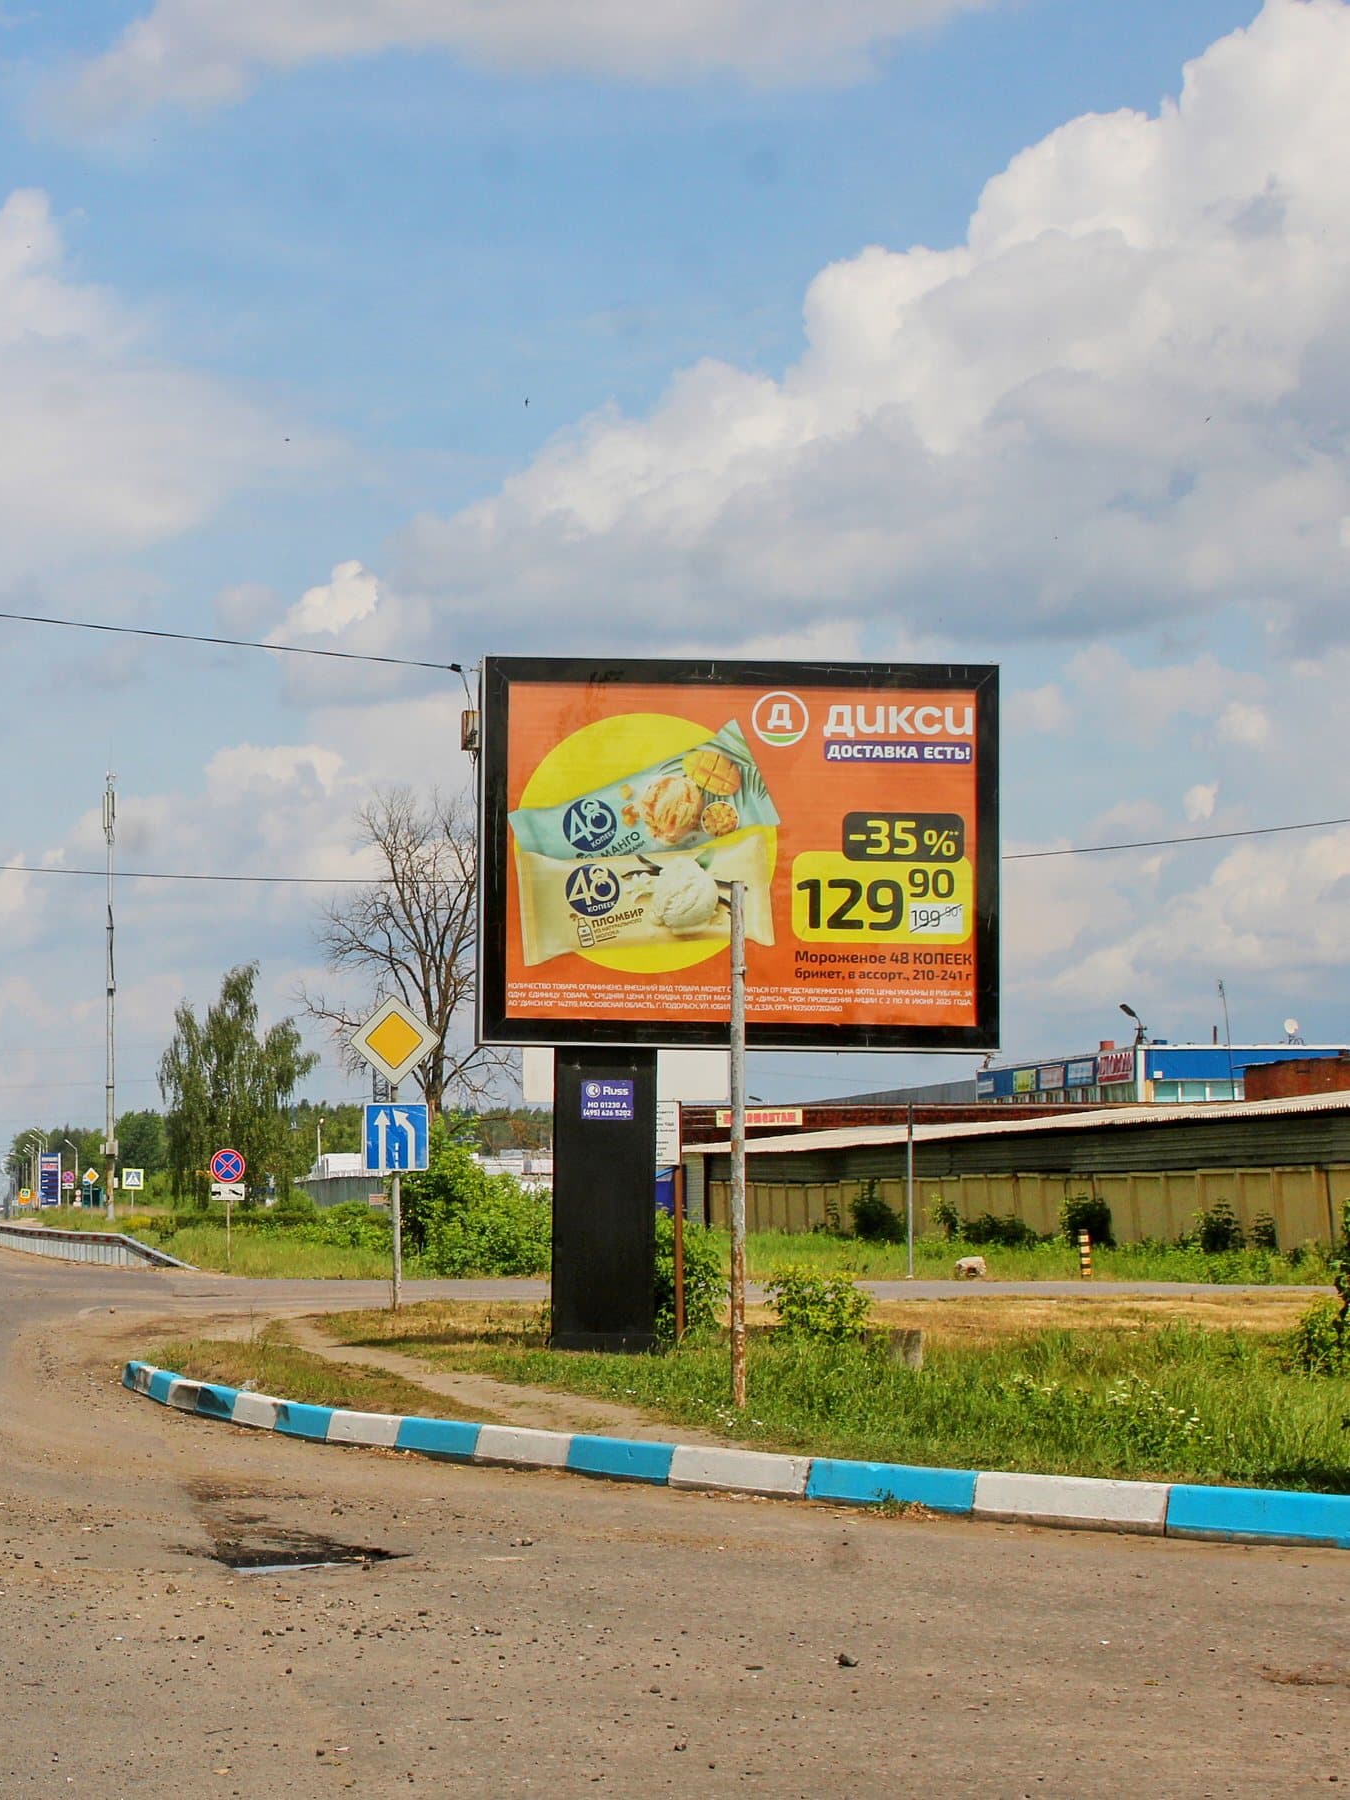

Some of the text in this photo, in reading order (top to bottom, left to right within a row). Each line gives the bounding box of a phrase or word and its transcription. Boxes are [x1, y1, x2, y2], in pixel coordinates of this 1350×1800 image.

[766, 703, 793, 730] Д
[826, 744, 971, 760] ДОСТАВКА ЕСТЬ!
[569, 799, 612, 844] 48
[568, 865, 616, 906] 48
[586, 900, 617, 913] КОПЕЕК
[795, 868, 955, 932] 129 90
[591, 908, 644, 928] ПЛОМБИР
[911, 910, 941, 928] 199
[794, 950, 973, 967] Мороженое 48 КОПЕЕК
[794, 967, 973, 983] брикет, в ассорт., 210-241 г
[602, 1085, 629, 1096] Russ
[722, 1112, 797, 1125] ШОМОНТАЖ
